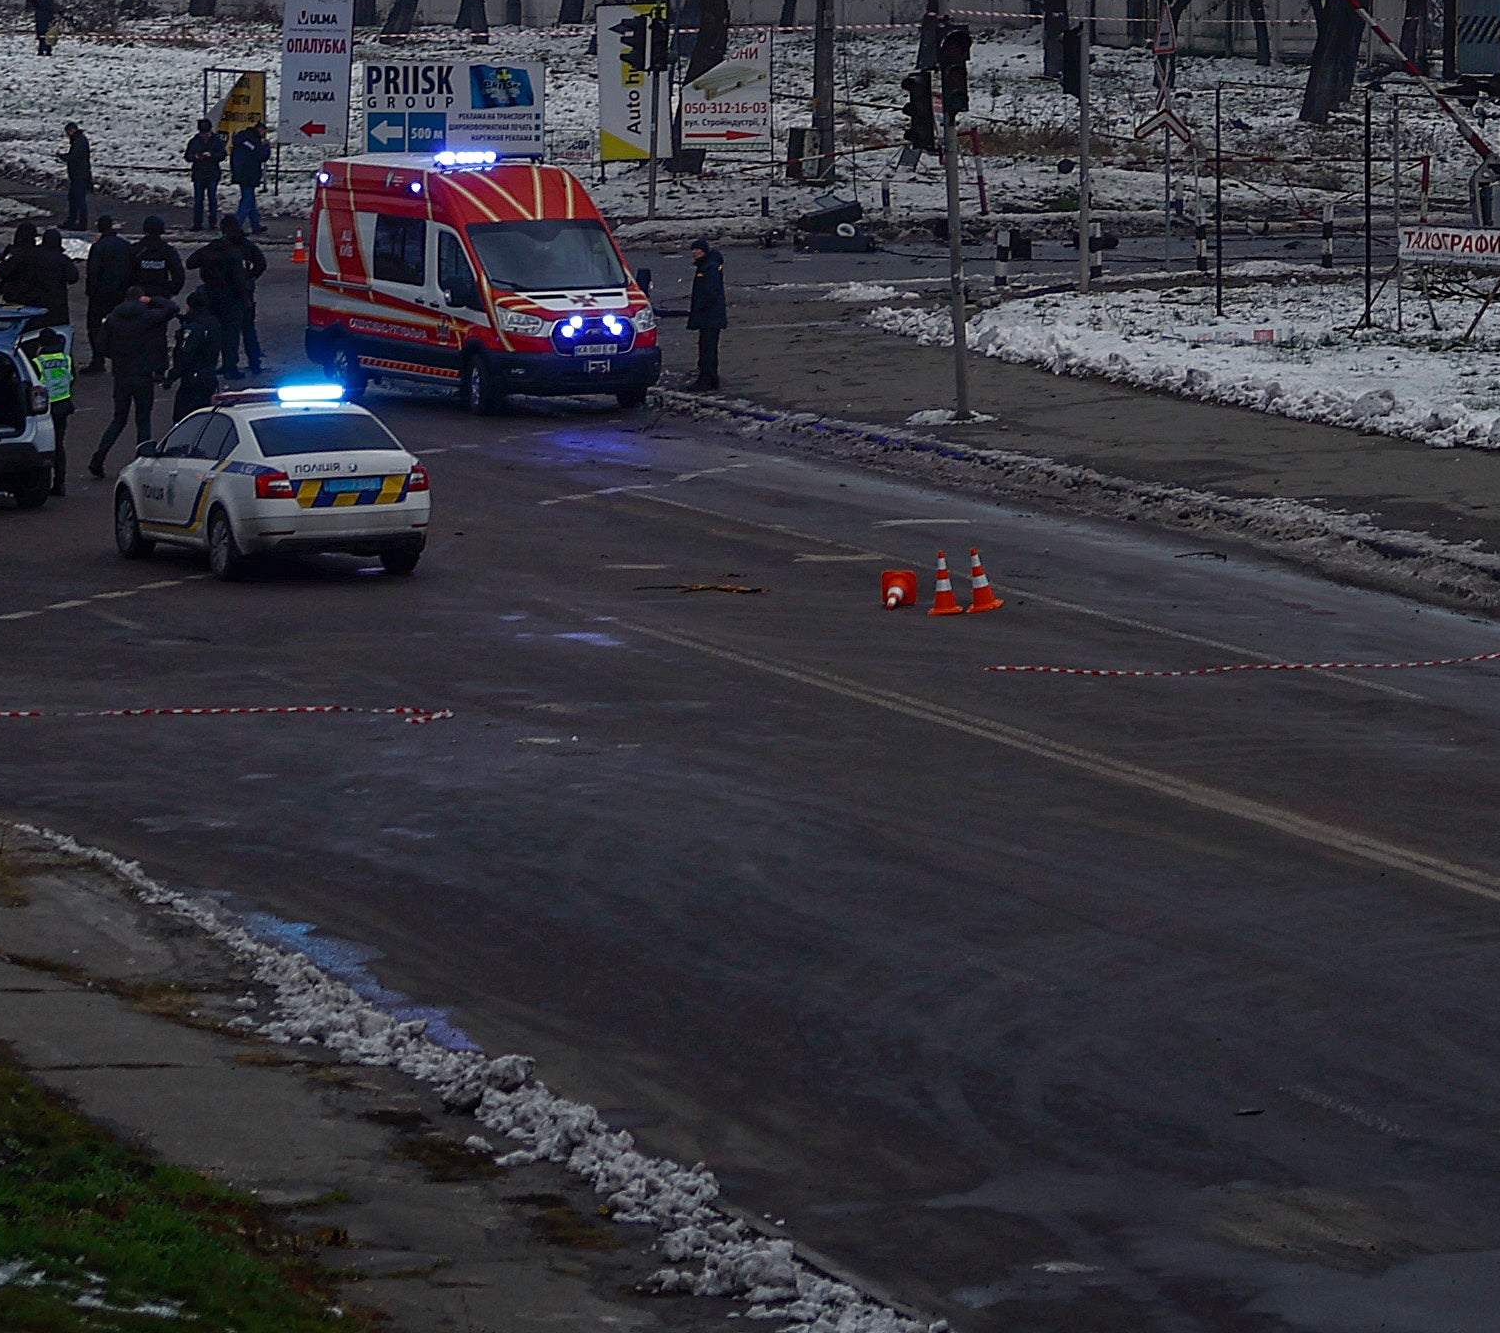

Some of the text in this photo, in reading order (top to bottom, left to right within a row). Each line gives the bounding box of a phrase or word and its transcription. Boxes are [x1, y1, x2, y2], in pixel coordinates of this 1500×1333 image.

[310, 14, 338, 25] ULMA
[286, 38, 347, 55] ОПАЛУБКА
[297, 71, 332, 83] АРЕНДА
[366, 65, 455, 95] PRIISK
[292, 90, 336, 103] ПРОДАЖА
[367, 96, 455, 109] GROUP
[626, 89, 642, 135] Auto
[684, 102, 767, 114] 050-312-16-03
[410, 127, 432, 140] 500
[294, 462, 341, 474] ПОЛІЦІЯ
